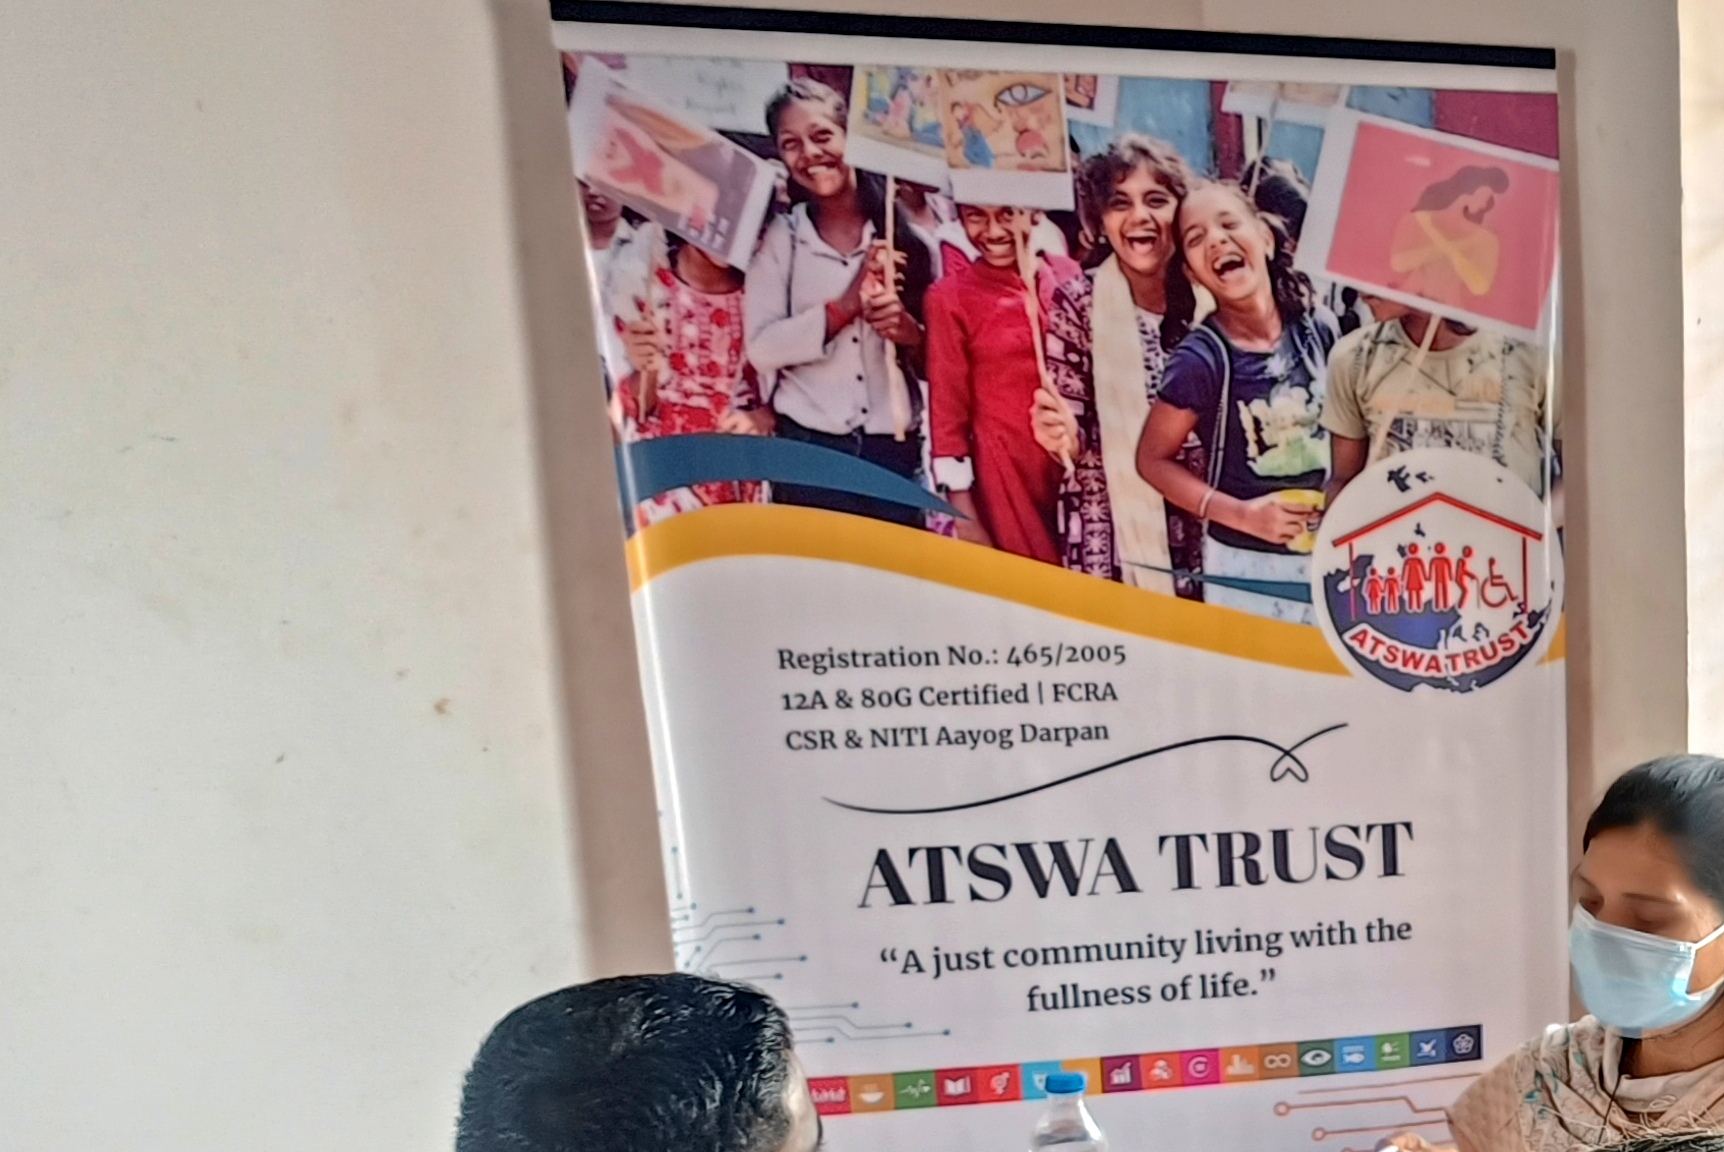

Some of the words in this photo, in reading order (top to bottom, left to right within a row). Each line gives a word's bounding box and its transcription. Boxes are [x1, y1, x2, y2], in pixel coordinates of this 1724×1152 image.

[778, 648, 940, 675] Registration
[948, 646, 999, 667] No.:
[1006, 643, 1126, 668] 465/2005
[782, 691, 828, 711] 12A
[835, 690, 855, 709] &
[919, 683, 1029, 707] Certified
[1052, 682, 1119, 703] FCRA
[786, 730, 838, 750] CSR
[844, 729, 863, 748] &
[870, 727, 928, 748] NITI
[935, 725, 1013, 750] Aayog
[1020, 723, 1109, 748] Darpan
[858, 837, 1144, 909] ATSWA
[1158, 821, 1414, 892] TRUST
[932, 946, 995, 979] just
[1003, 934, 1186, 969] community
[1195, 926, 1283, 957] living
[1290, 920, 1357, 949] with
[1365, 917, 1413, 943] the
[1027, 980, 1151, 1013] fullness
[1160, 974, 1192, 1003] of
